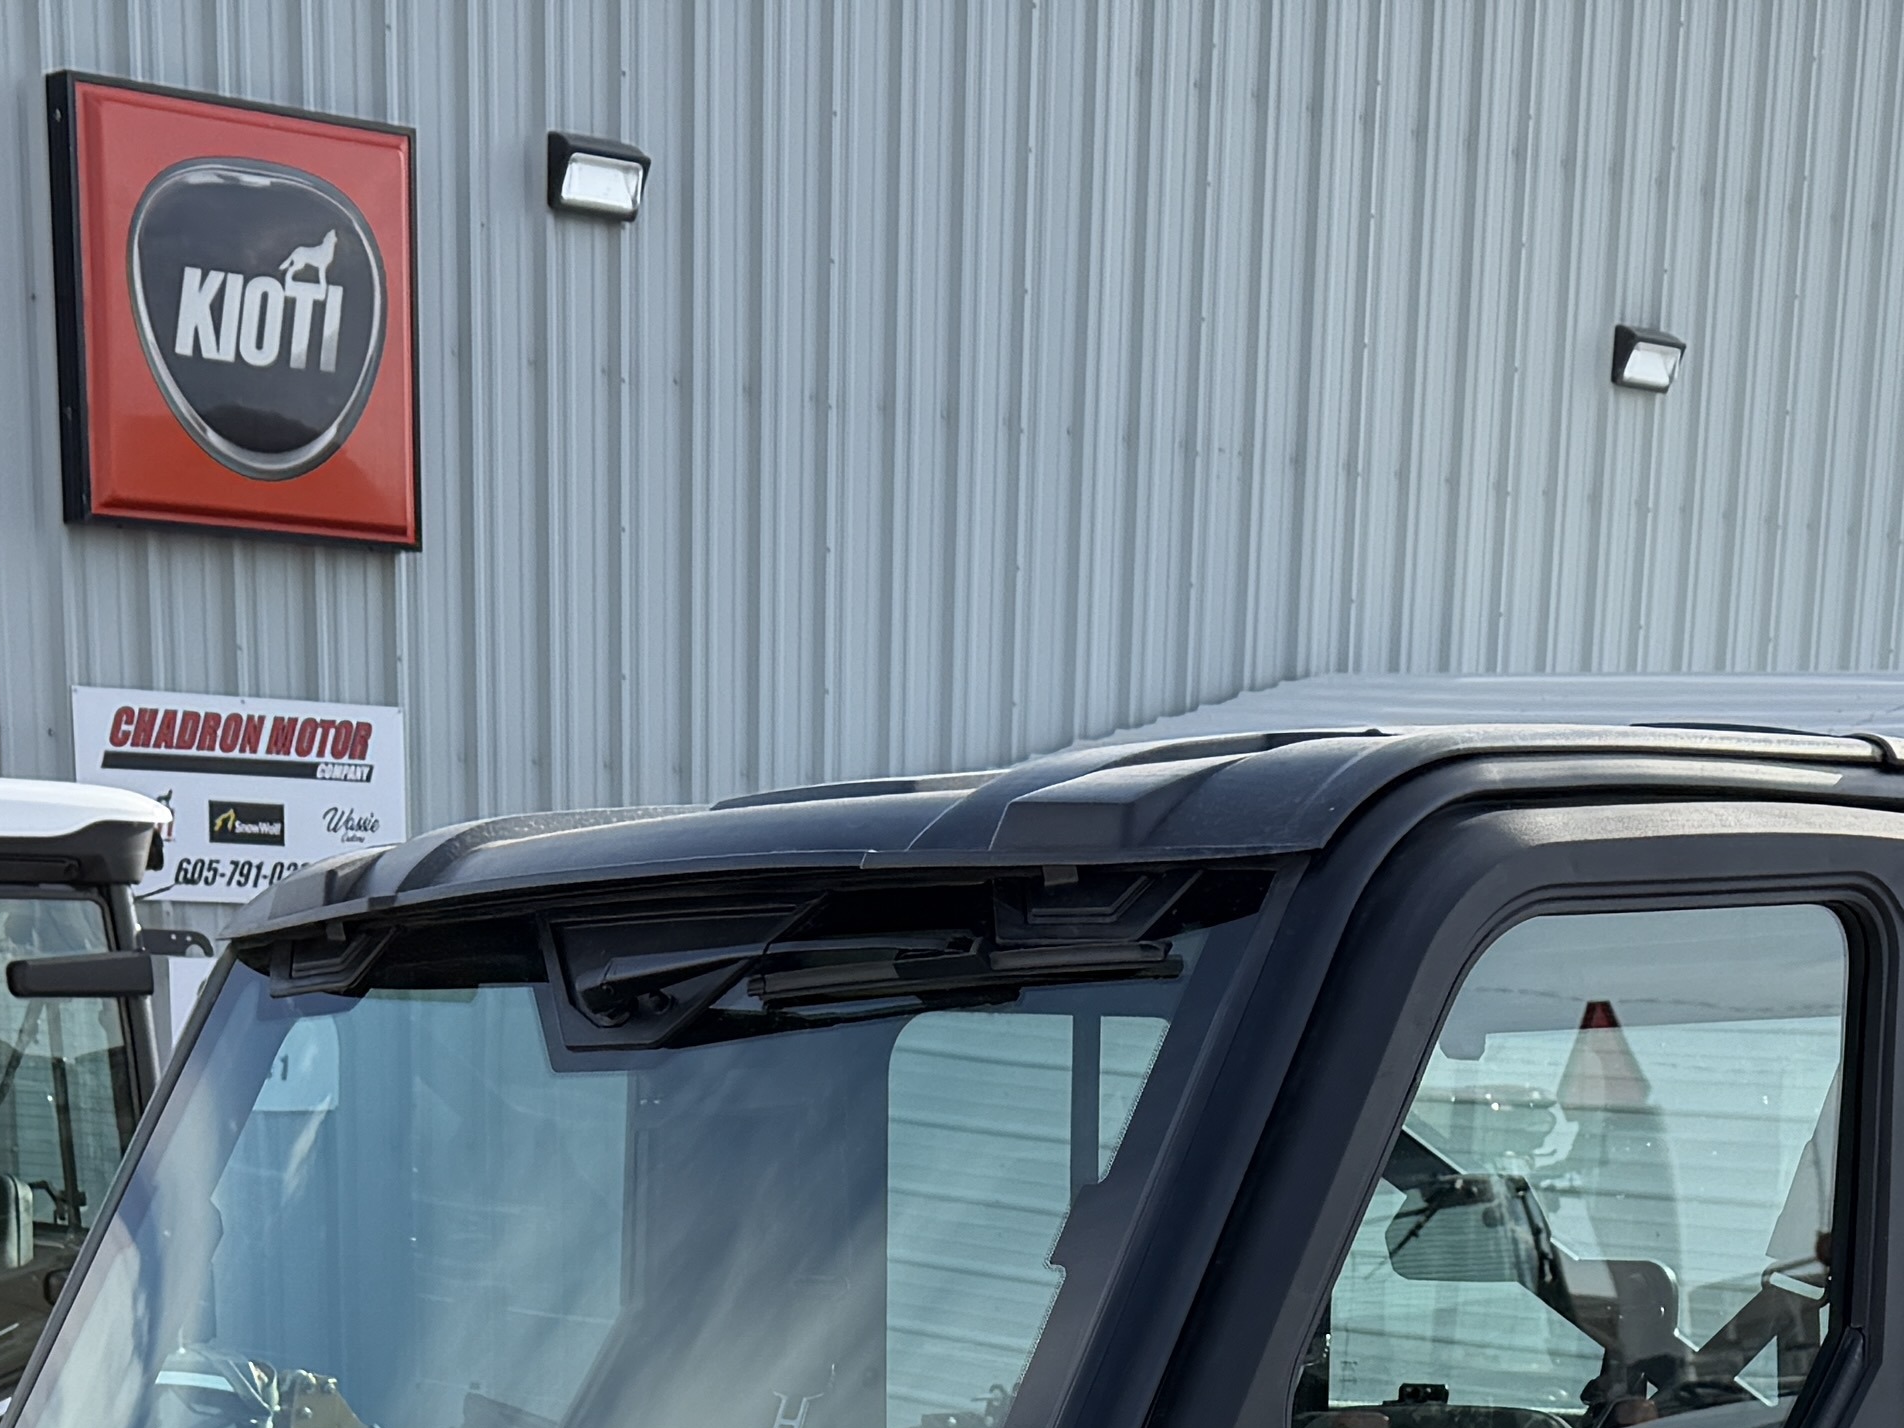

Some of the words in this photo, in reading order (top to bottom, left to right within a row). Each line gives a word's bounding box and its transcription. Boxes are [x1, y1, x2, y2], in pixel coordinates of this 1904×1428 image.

[174, 265, 344, 374] KIOTI
[108, 705, 265, 755] CHADRON
[266, 716, 373, 761] MOTOR
[316, 763, 371, 783] COMPANY
[175, 857, 310, 888] 605-791-0
